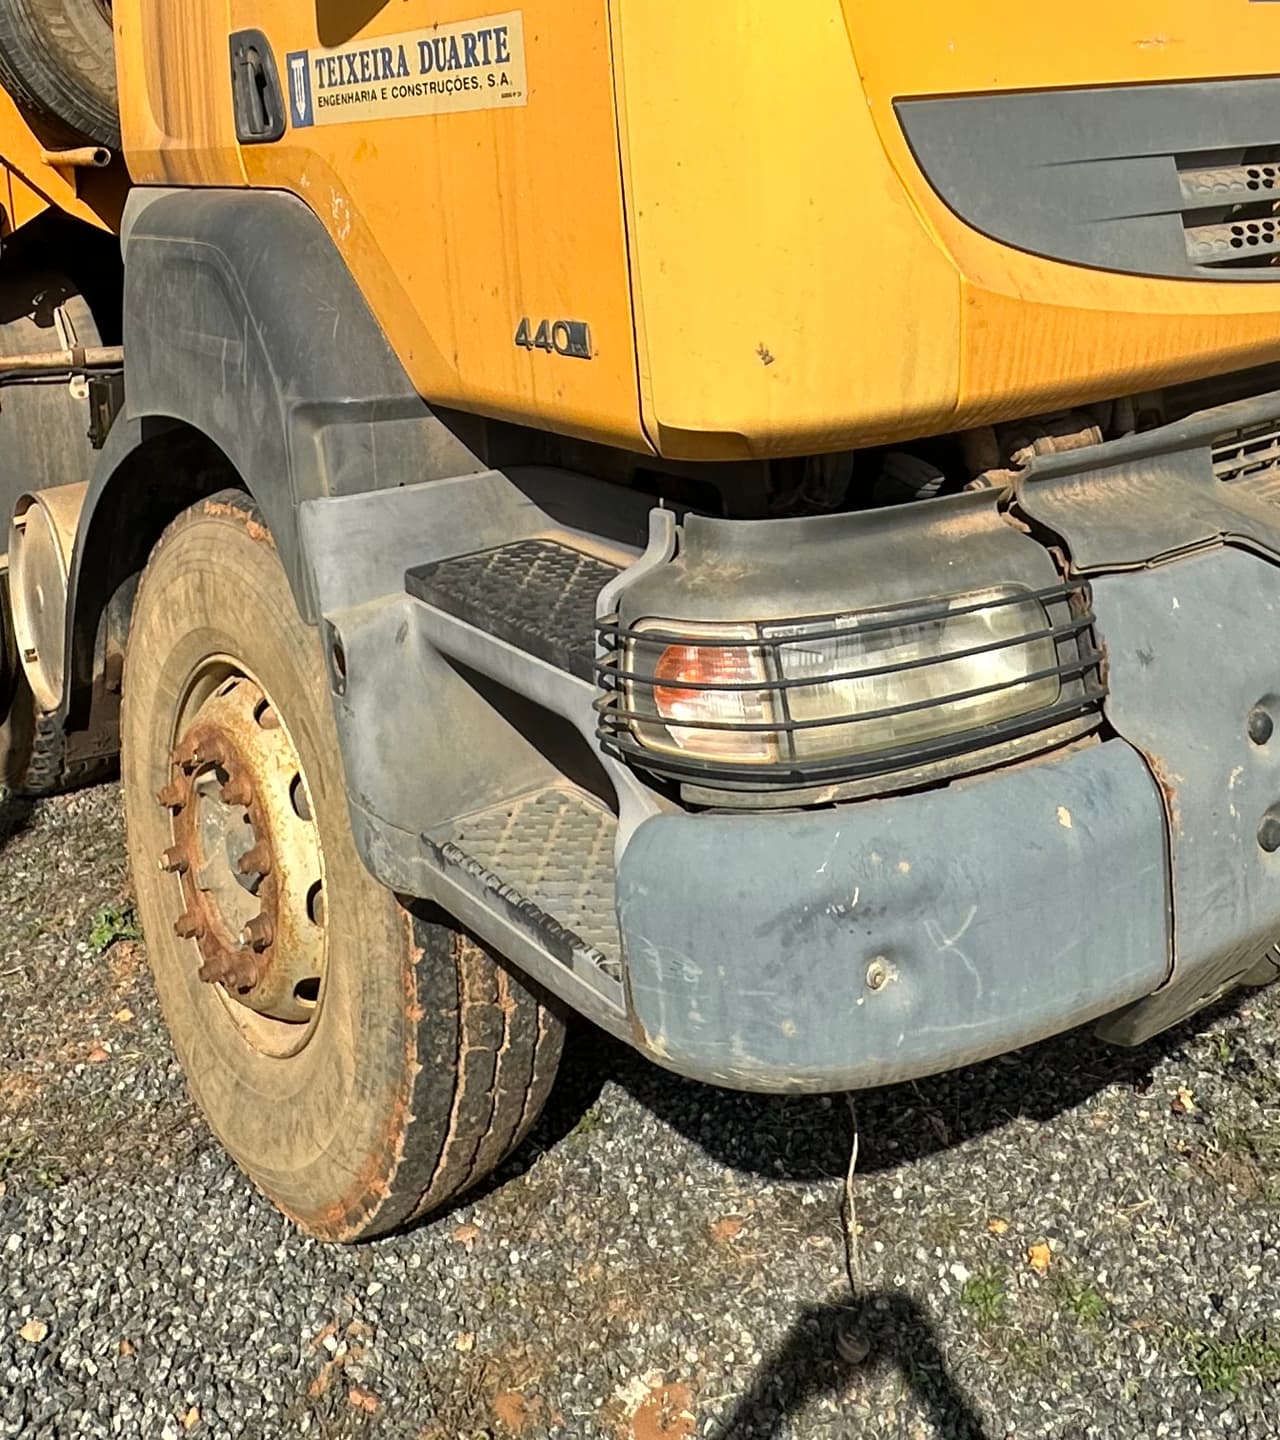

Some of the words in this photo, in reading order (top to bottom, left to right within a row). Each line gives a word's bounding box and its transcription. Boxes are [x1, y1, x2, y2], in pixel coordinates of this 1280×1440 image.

[314, 45, 410, 89] TEIXEIRA
[418, 26, 510, 74] DUARTE
[317, 90, 377, 108] ENGENHARIA
[381, 87, 387, 100] E
[487, 72, 513, 87] S.A.
[515, 317, 570, 356] 440
